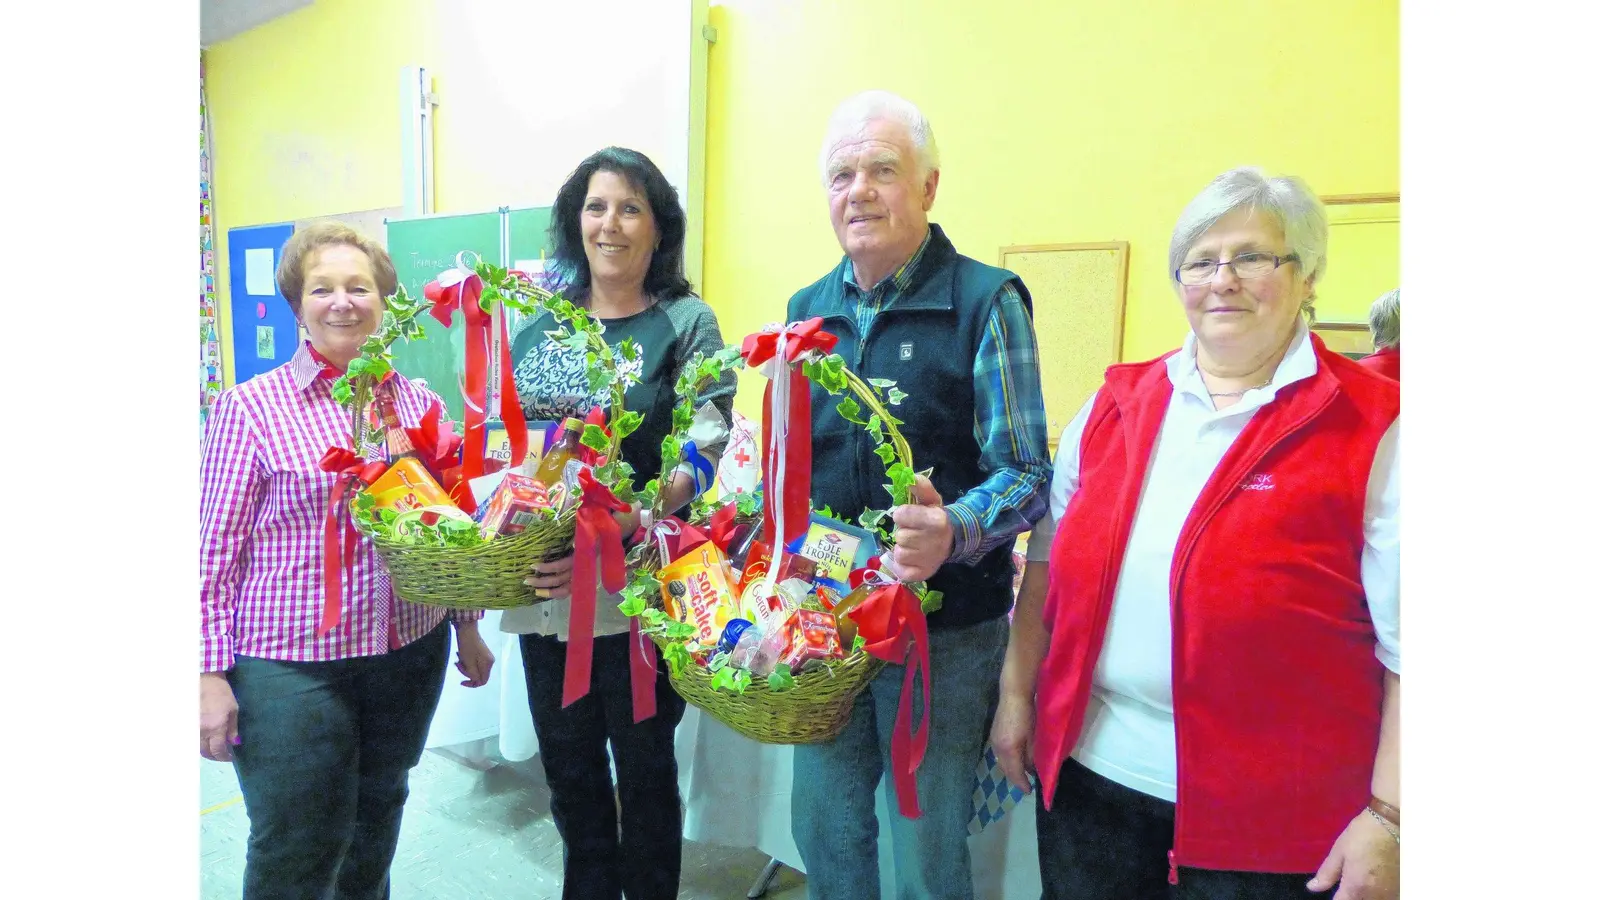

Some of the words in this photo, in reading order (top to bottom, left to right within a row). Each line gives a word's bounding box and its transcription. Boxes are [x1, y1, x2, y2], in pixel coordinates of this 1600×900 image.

[447, 254, 472, 268] 216
[806, 546, 849, 568] TROPFEN
[697, 571, 718, 609] soft
[691, 593, 712, 640] cake
